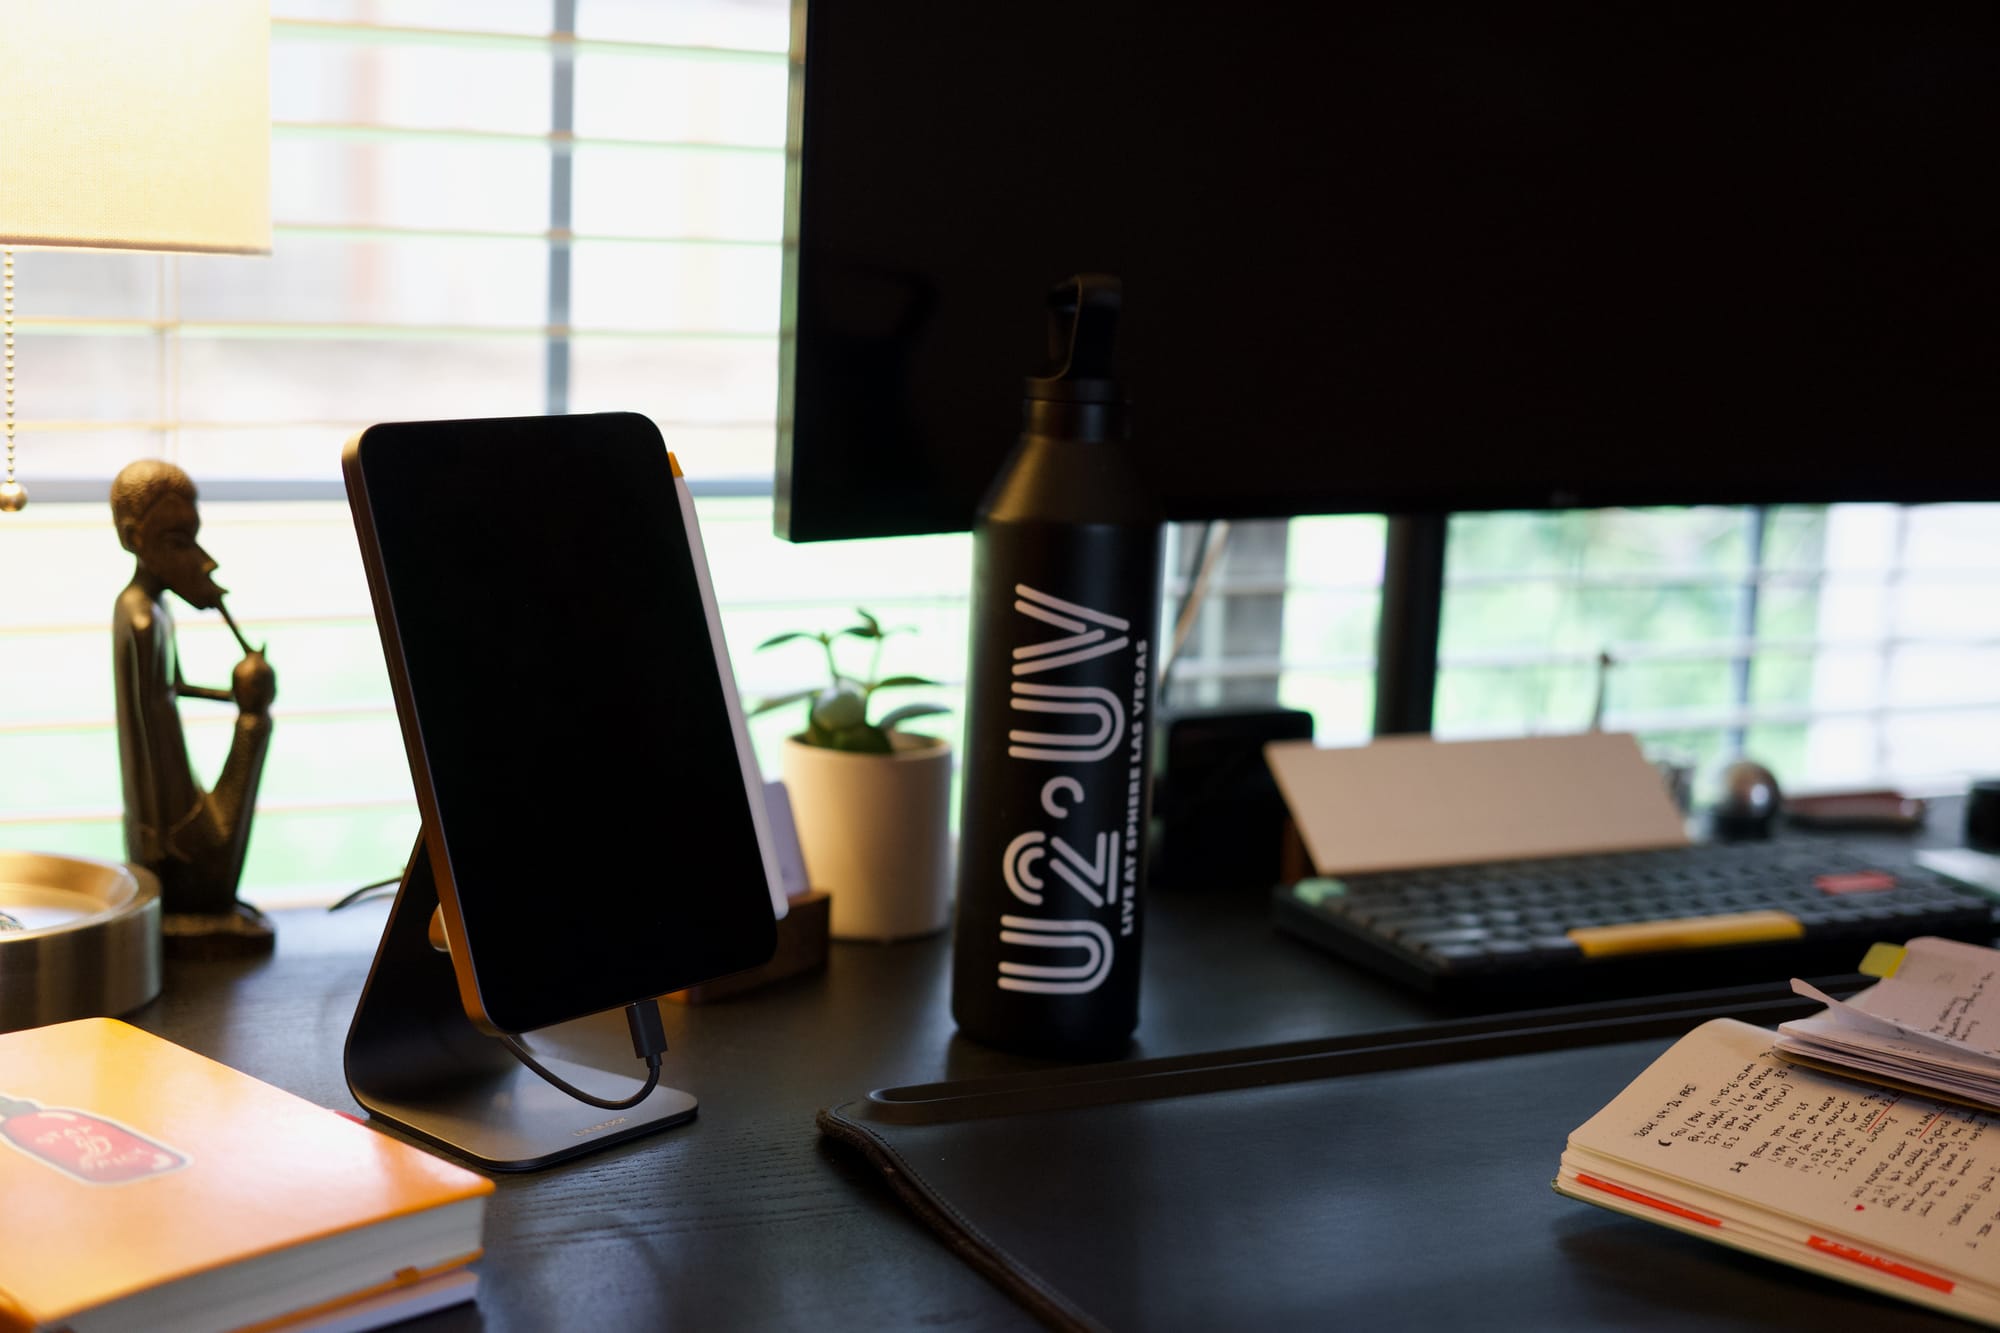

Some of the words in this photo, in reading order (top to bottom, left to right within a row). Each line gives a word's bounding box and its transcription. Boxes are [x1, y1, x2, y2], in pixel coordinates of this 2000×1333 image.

[1132, 639, 1147, 717] VEGAS
[1130, 721, 1143, 763] LAS
[1126, 767, 1141, 851] SPHERE
[1124, 855, 1136, 882] AT
[1121, 885, 1135, 936] LIVE
